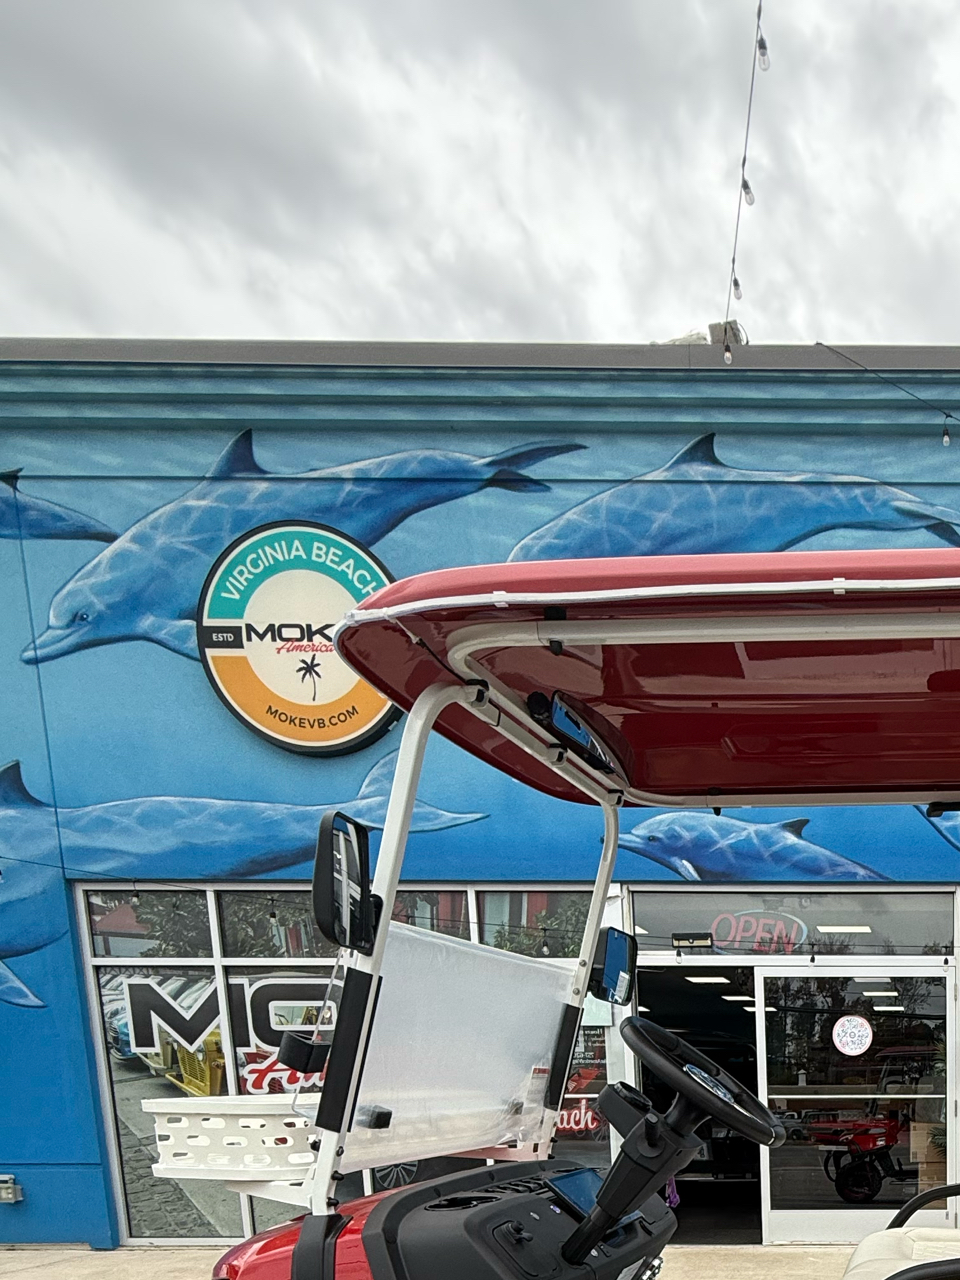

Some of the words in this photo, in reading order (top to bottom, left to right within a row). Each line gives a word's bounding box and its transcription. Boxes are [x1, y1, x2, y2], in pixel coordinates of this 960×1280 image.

[221, 539, 307, 601] VIRGINIA
[212, 632, 234, 642] ESTD
[245, 623, 336, 642] MOK
[276, 638, 335, 654] America
[265, 705, 359, 729] MOKEVB.COM
[711, 913, 799, 955] OPEN
[556, 1098, 597, 1131] ach
